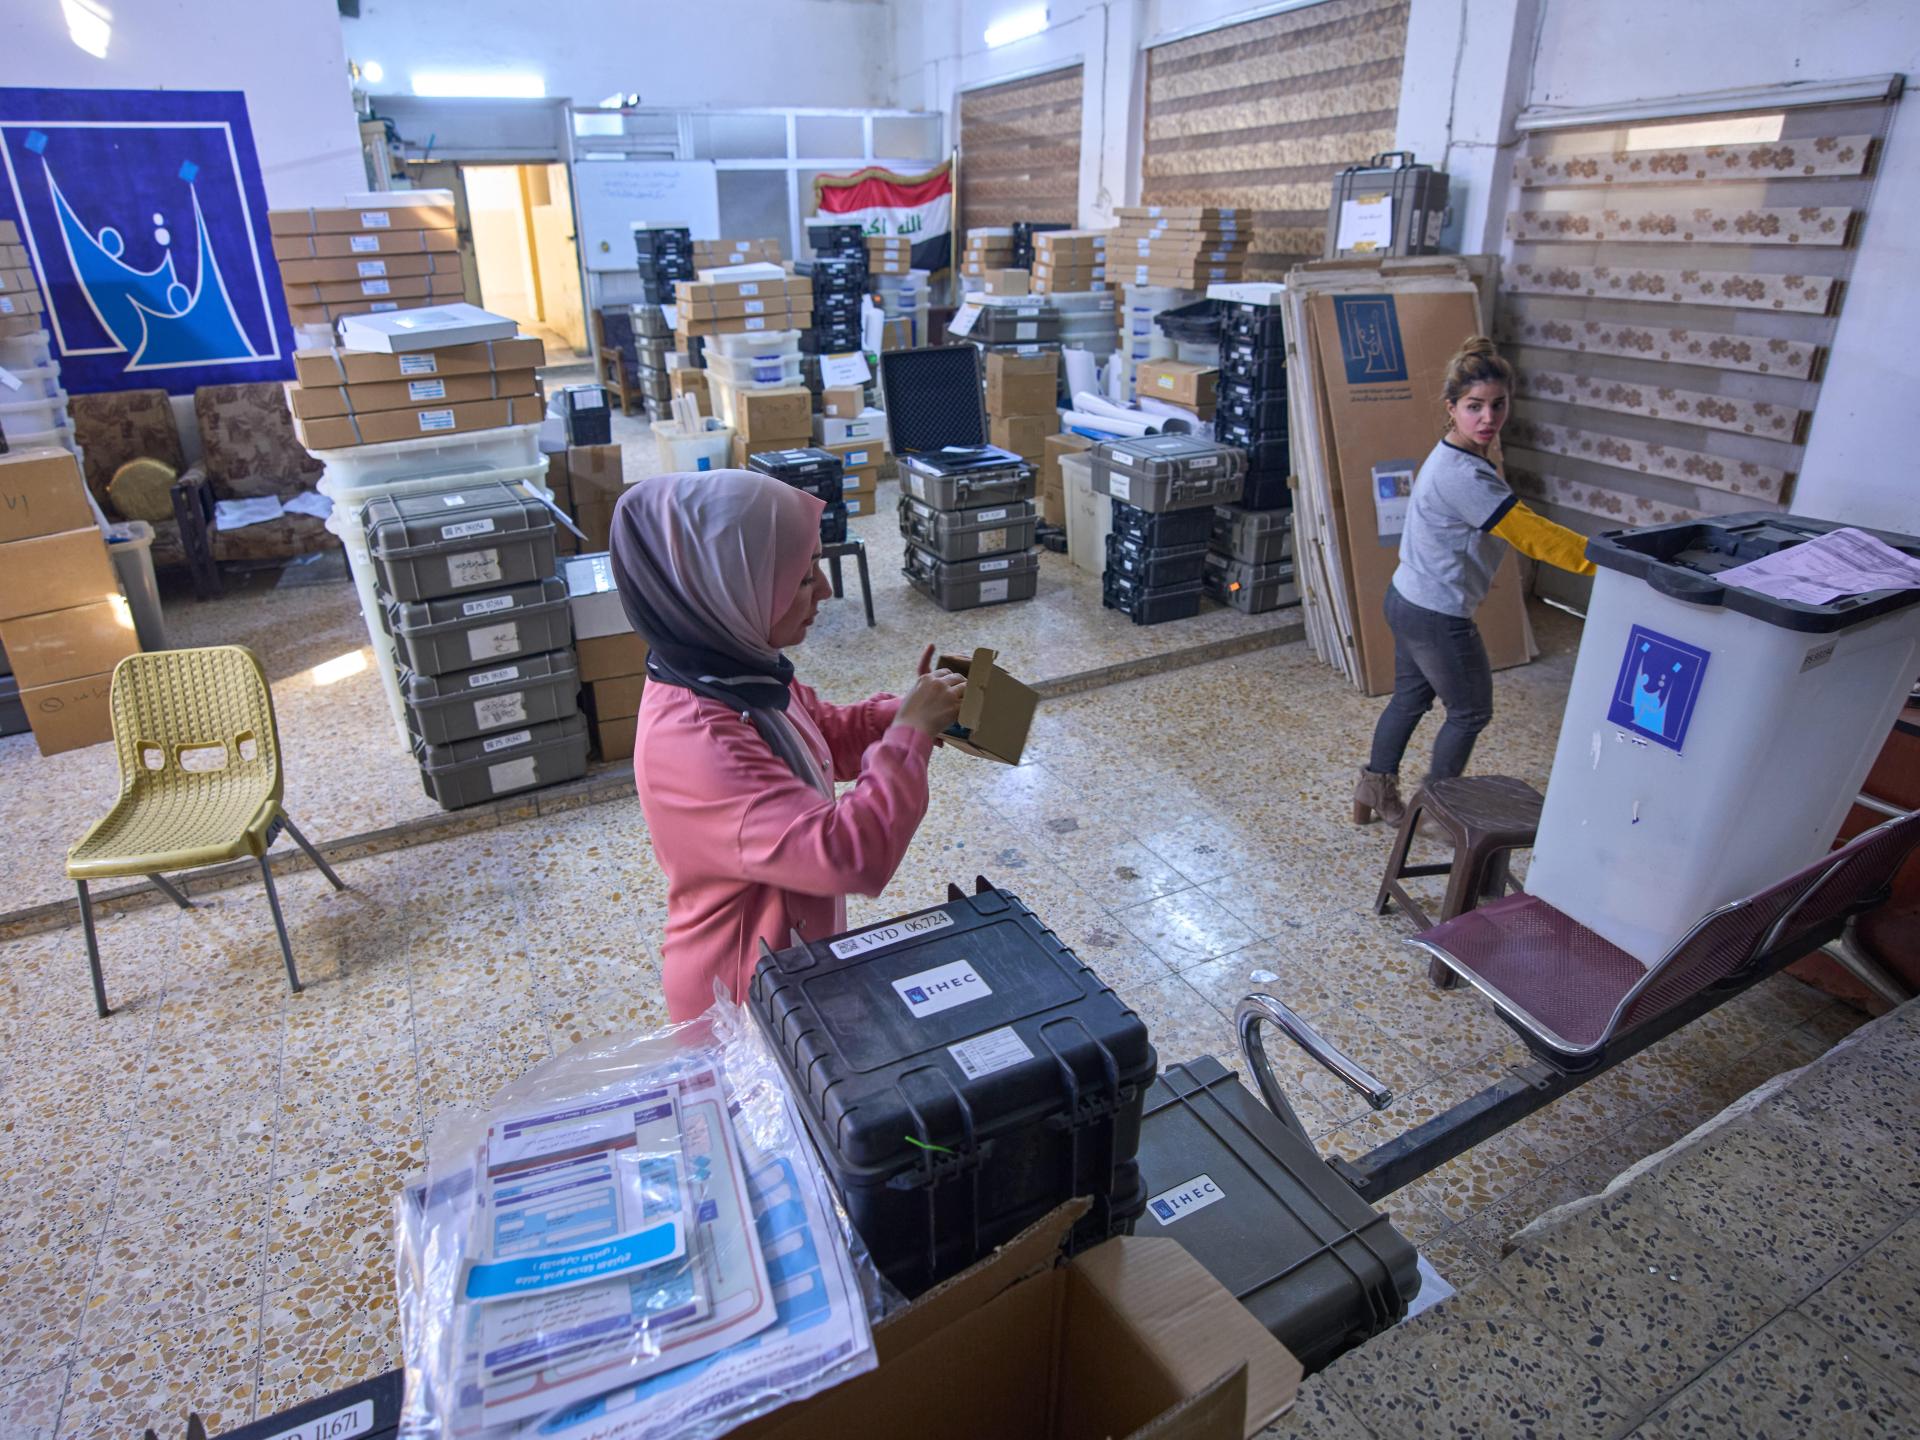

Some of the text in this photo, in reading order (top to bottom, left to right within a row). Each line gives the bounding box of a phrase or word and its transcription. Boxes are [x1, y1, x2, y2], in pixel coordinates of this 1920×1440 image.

[861, 928, 899, 945] VVD
[925, 973, 977, 996] IHEC
[1170, 1182, 1216, 1209] IHEC
[566, 1263, 595, 1276] محطة
